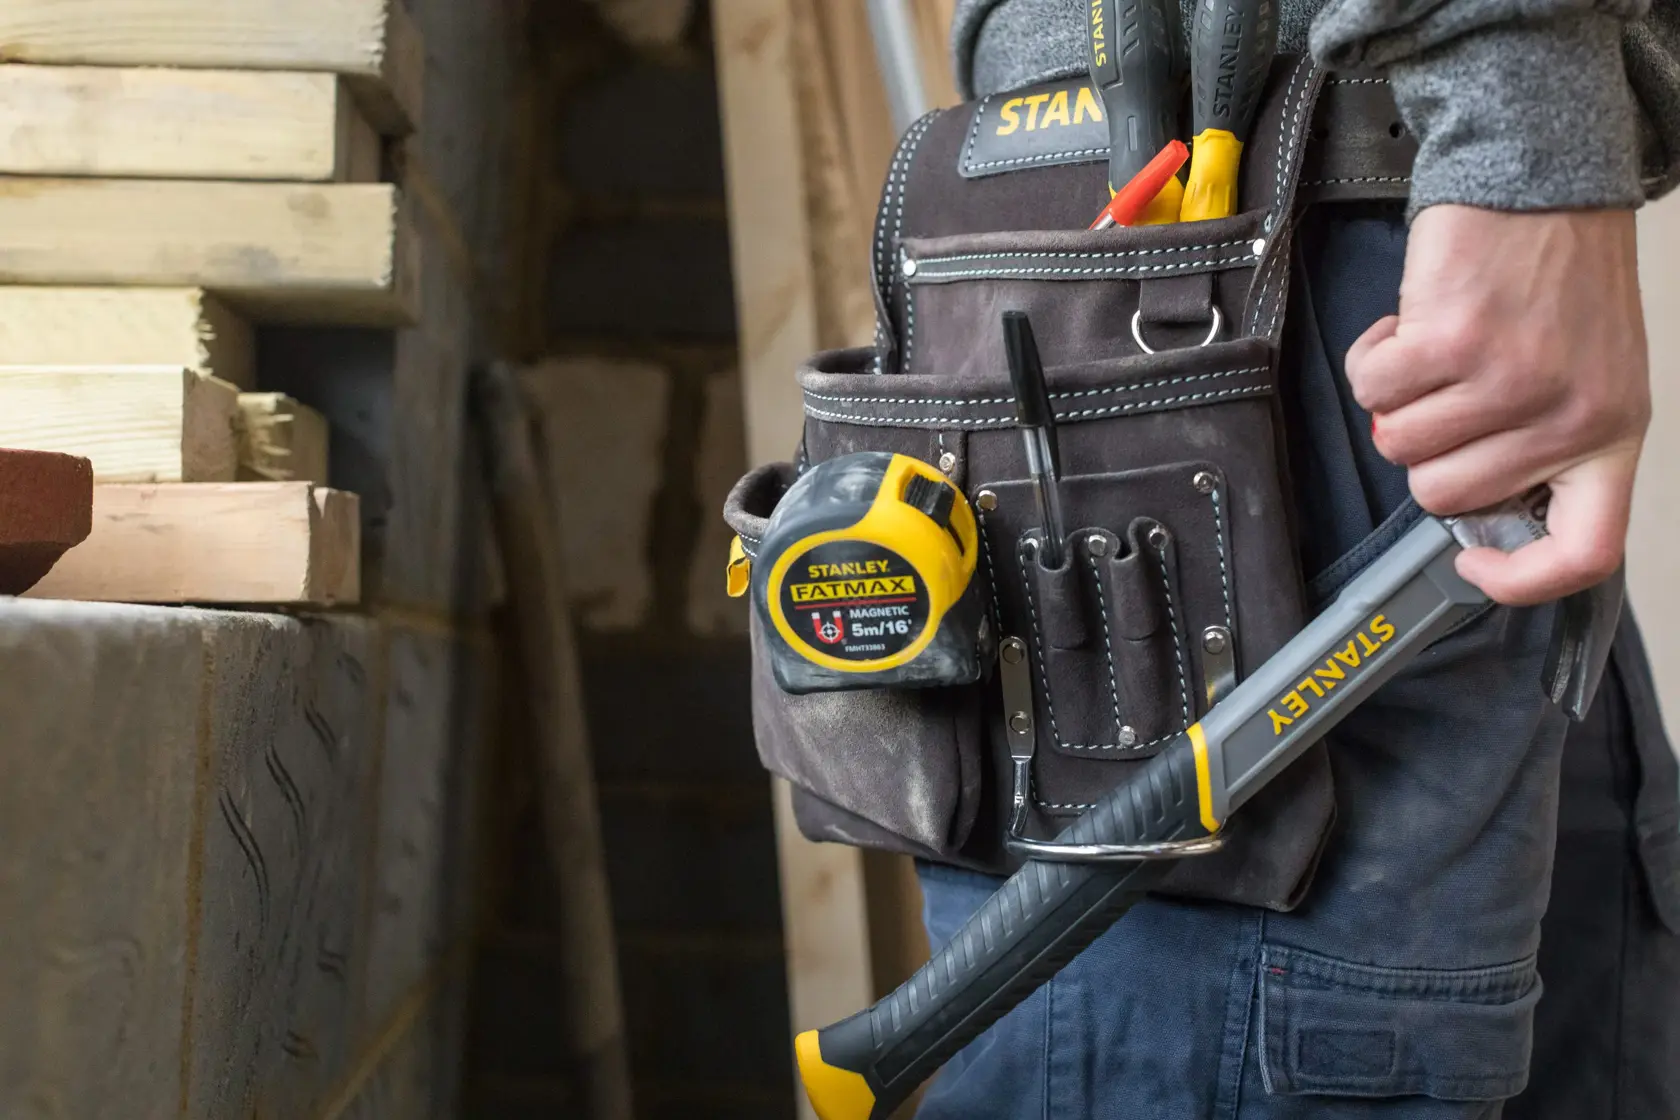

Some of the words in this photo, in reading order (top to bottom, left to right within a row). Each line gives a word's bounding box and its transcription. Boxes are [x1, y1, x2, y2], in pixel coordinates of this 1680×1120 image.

[1213, 4, 1245, 118] STANLEY
[809, 560, 888, 578] STANLEY
[796, 578, 907, 599] FATMAX
[849, 606, 909, 618] MAGNETIC
[851, 620, 912, 637] 5m/16'
[1267, 614, 1395, 736] STANLEY
